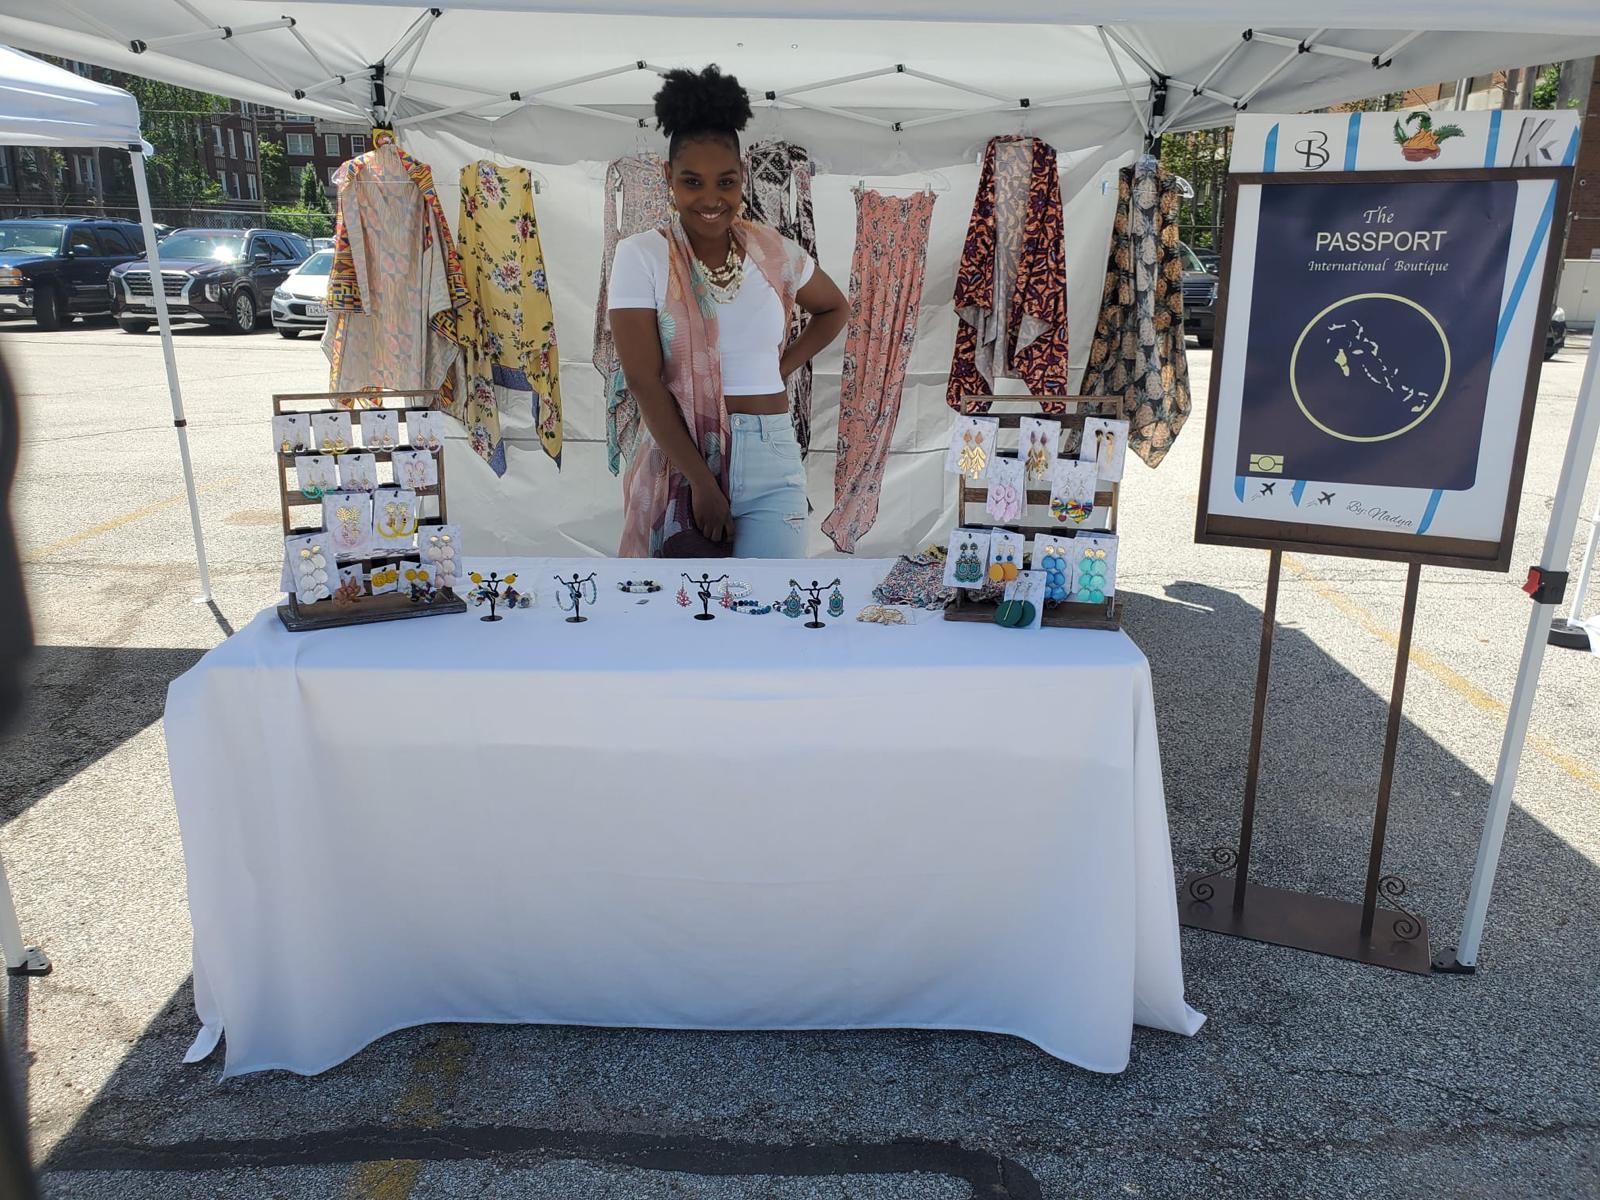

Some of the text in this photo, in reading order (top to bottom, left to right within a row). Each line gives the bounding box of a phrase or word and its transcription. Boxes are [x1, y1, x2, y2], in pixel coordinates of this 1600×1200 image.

[1363, 206, 1394, 224] The
[1315, 231, 1448, 252] PASSPORT
[1308, 258, 1449, 276] International Boutique
